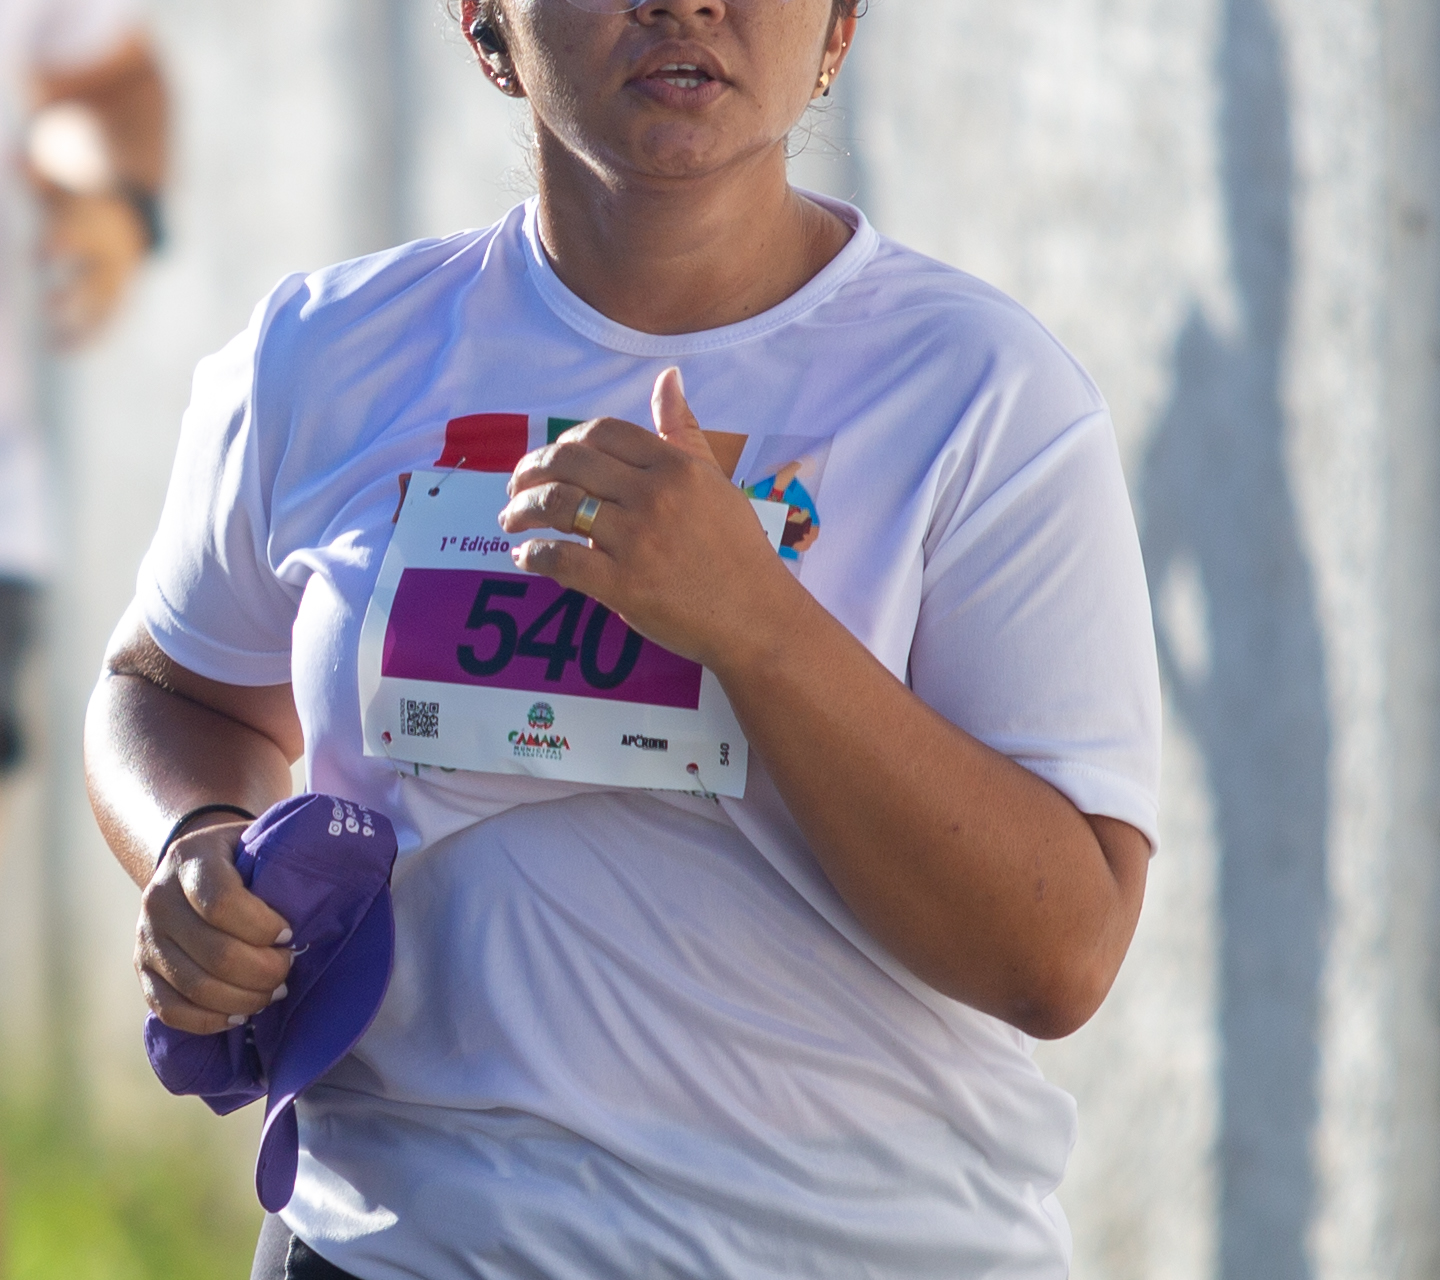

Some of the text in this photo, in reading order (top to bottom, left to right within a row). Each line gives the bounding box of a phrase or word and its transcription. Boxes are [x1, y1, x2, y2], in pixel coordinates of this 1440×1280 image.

[459, 535, 510, 556] Edição
[456, 578, 644, 690] 540
[513, 745, 562, 756] MUNICIPAL
[719, 742, 730, 766] 540
